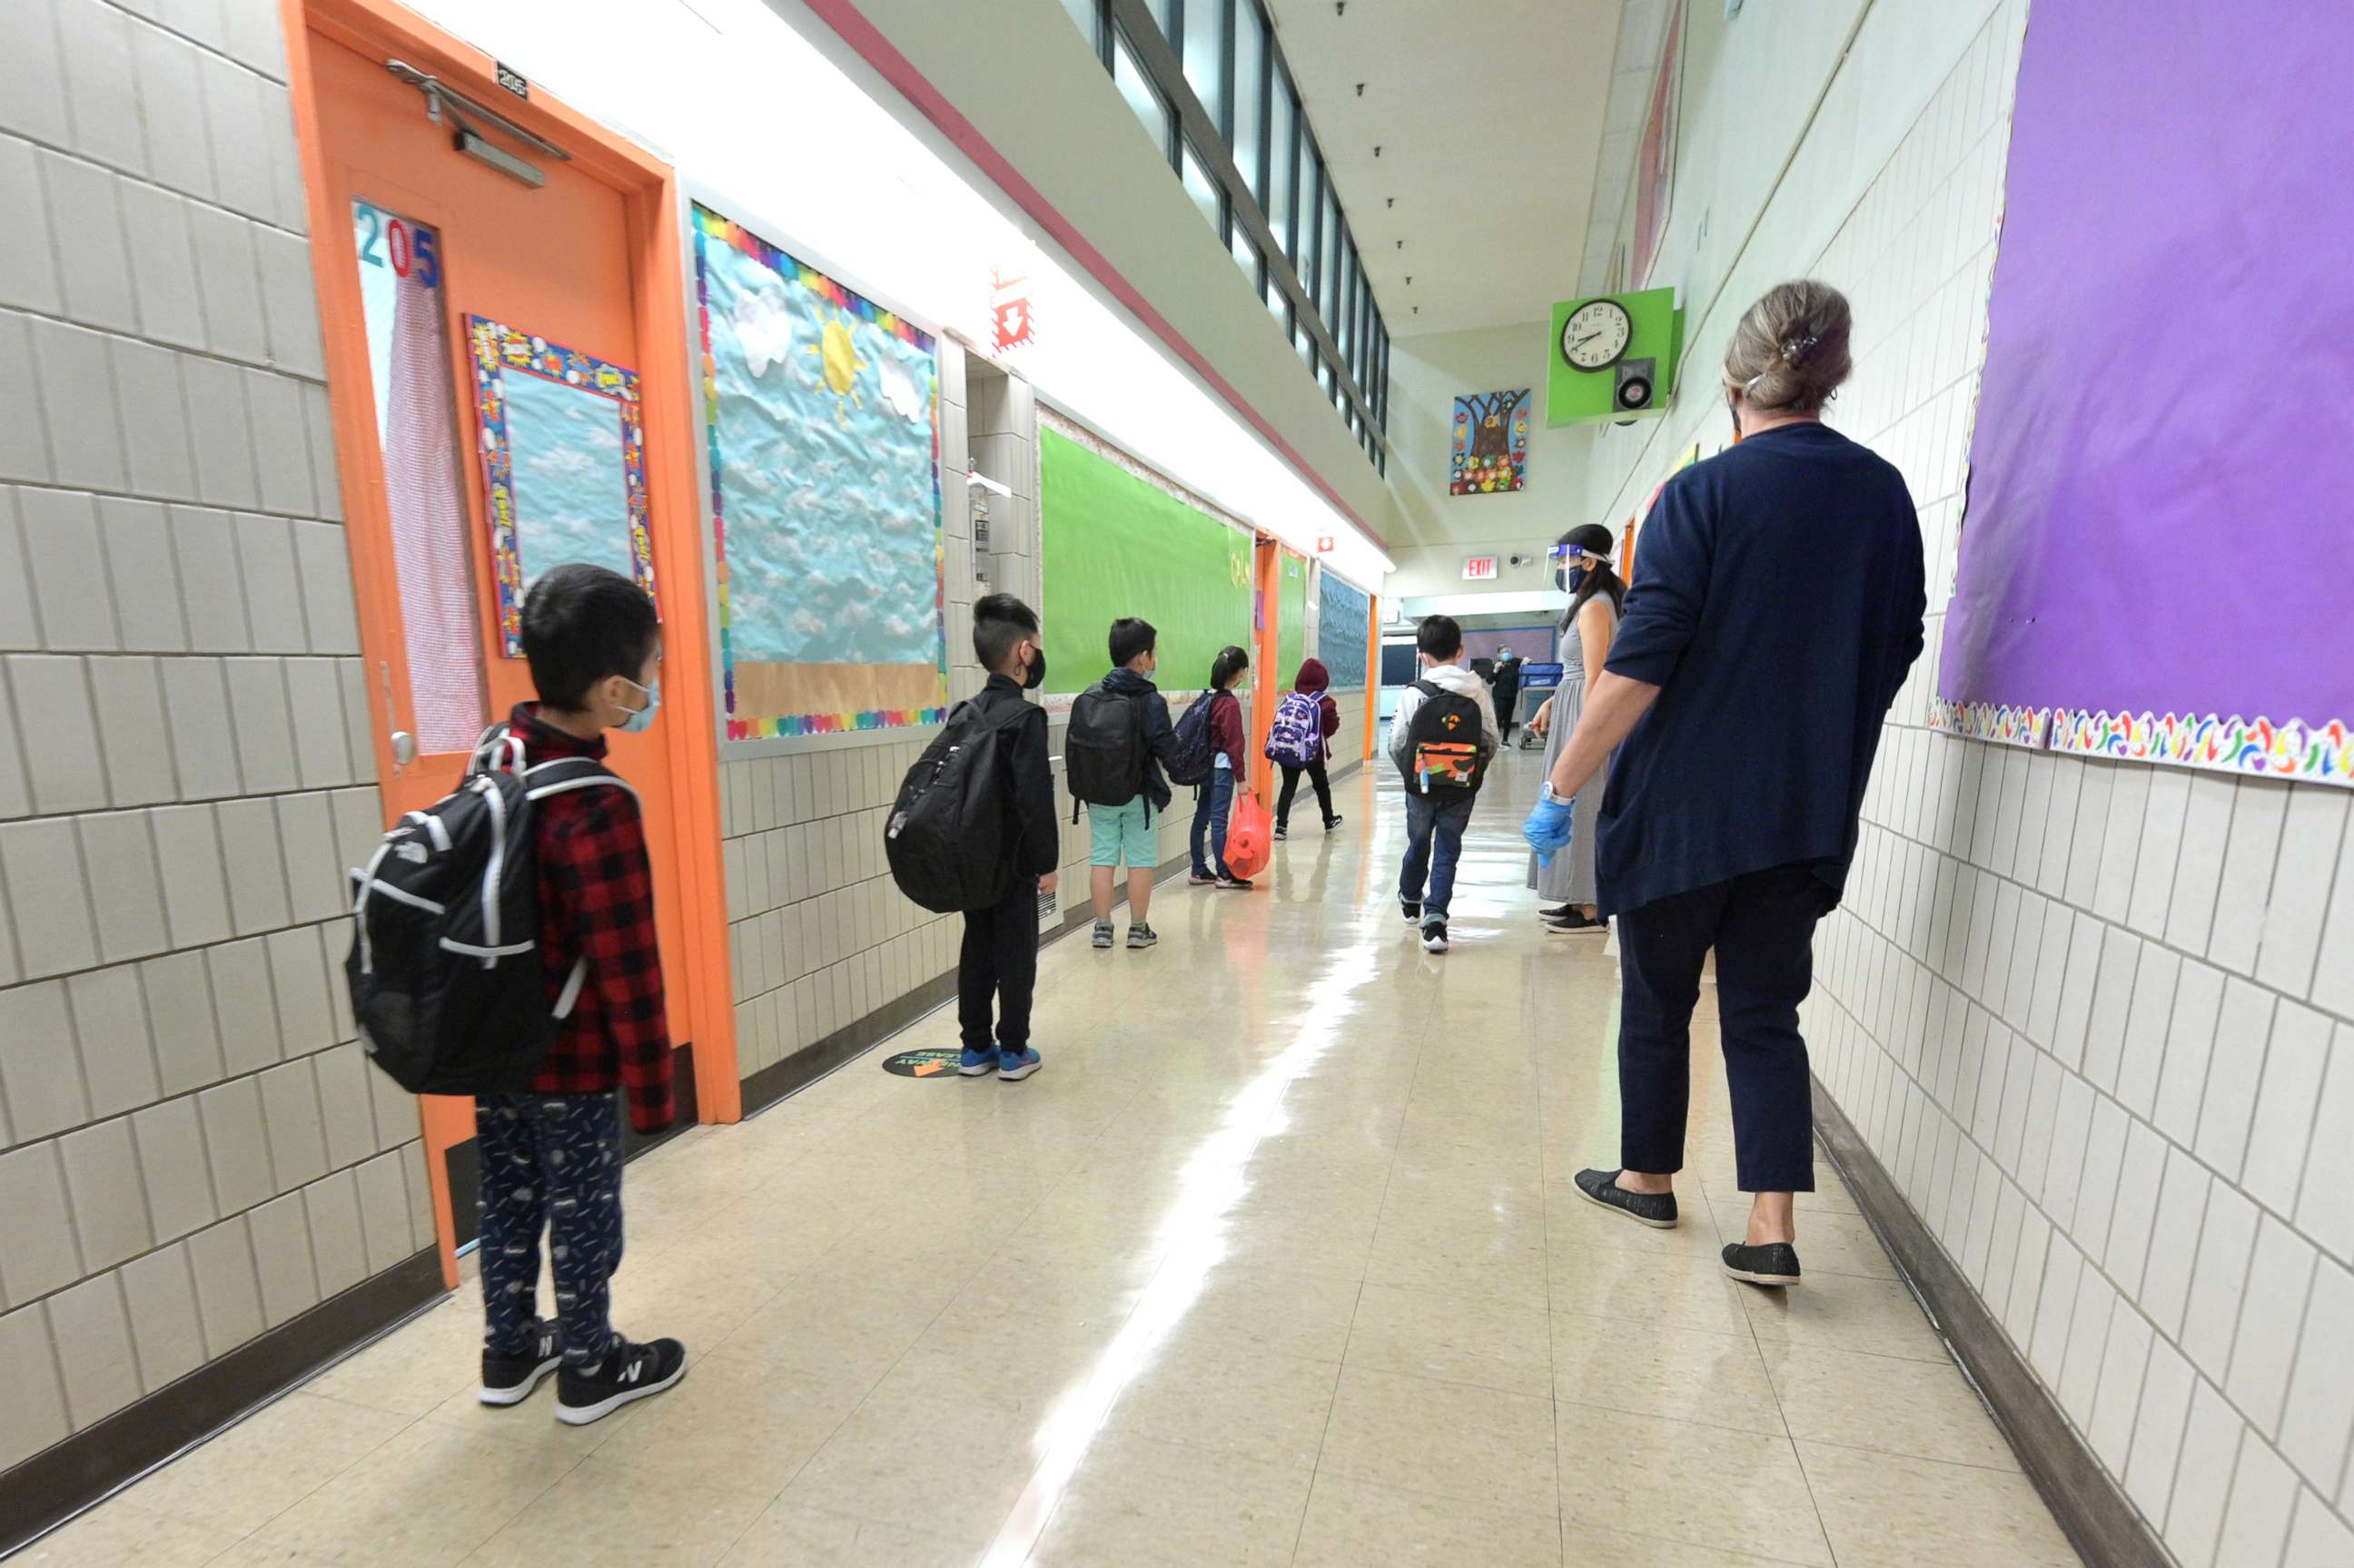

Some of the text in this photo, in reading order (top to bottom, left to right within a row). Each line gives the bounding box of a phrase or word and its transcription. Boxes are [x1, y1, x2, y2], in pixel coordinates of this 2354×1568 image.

[356, 203, 441, 290] 205
[1582, 311, 1589, 322] 11
[1593, 305, 1603, 318] 12
[1609, 309, 1613, 319] 1
[1572, 322, 1582, 332] 10
[1615, 316, 1623, 326] 2
[1617, 327, 1625, 338] 3
[1469, 558, 1491, 577] EXIT
[538, 1335, 553, 1357] N
[618, 1360, 643, 1383] N
